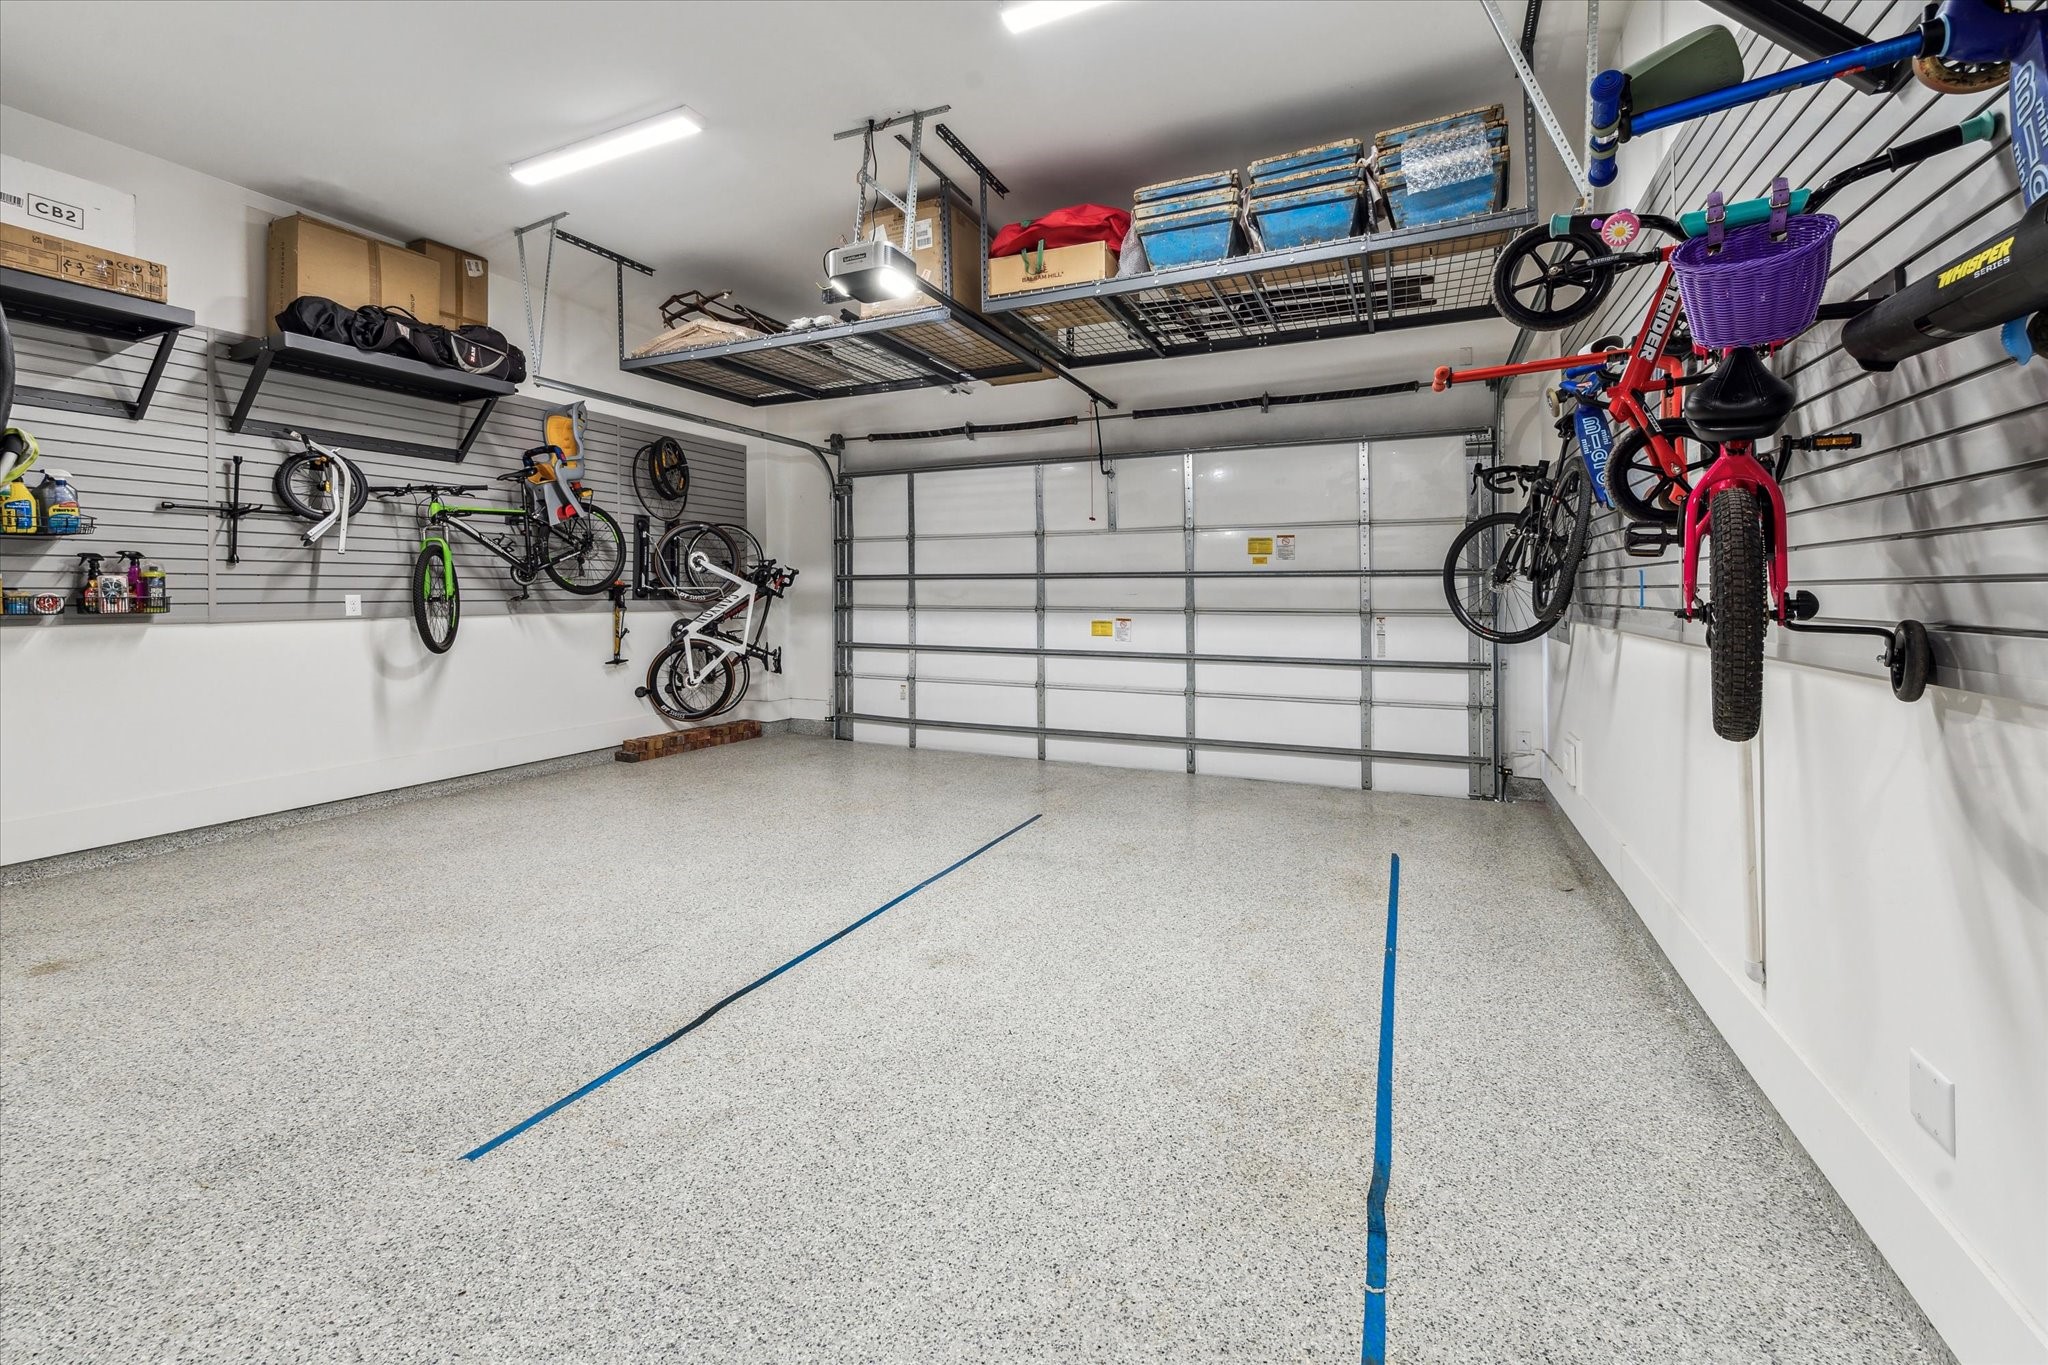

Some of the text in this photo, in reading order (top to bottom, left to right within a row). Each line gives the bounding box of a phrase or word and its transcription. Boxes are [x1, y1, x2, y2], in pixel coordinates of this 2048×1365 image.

[2013, 142, 2029, 189] mini
[35, 202, 77, 223] CB2
[1593, 254, 1620, 264] STRIDER
[1937, 236, 2015, 289] WHISPER
[1973, 255, 2011, 279] SERIES
[1581, 439, 1592, 455] mini
[1601, 429, 1611, 445] mini
